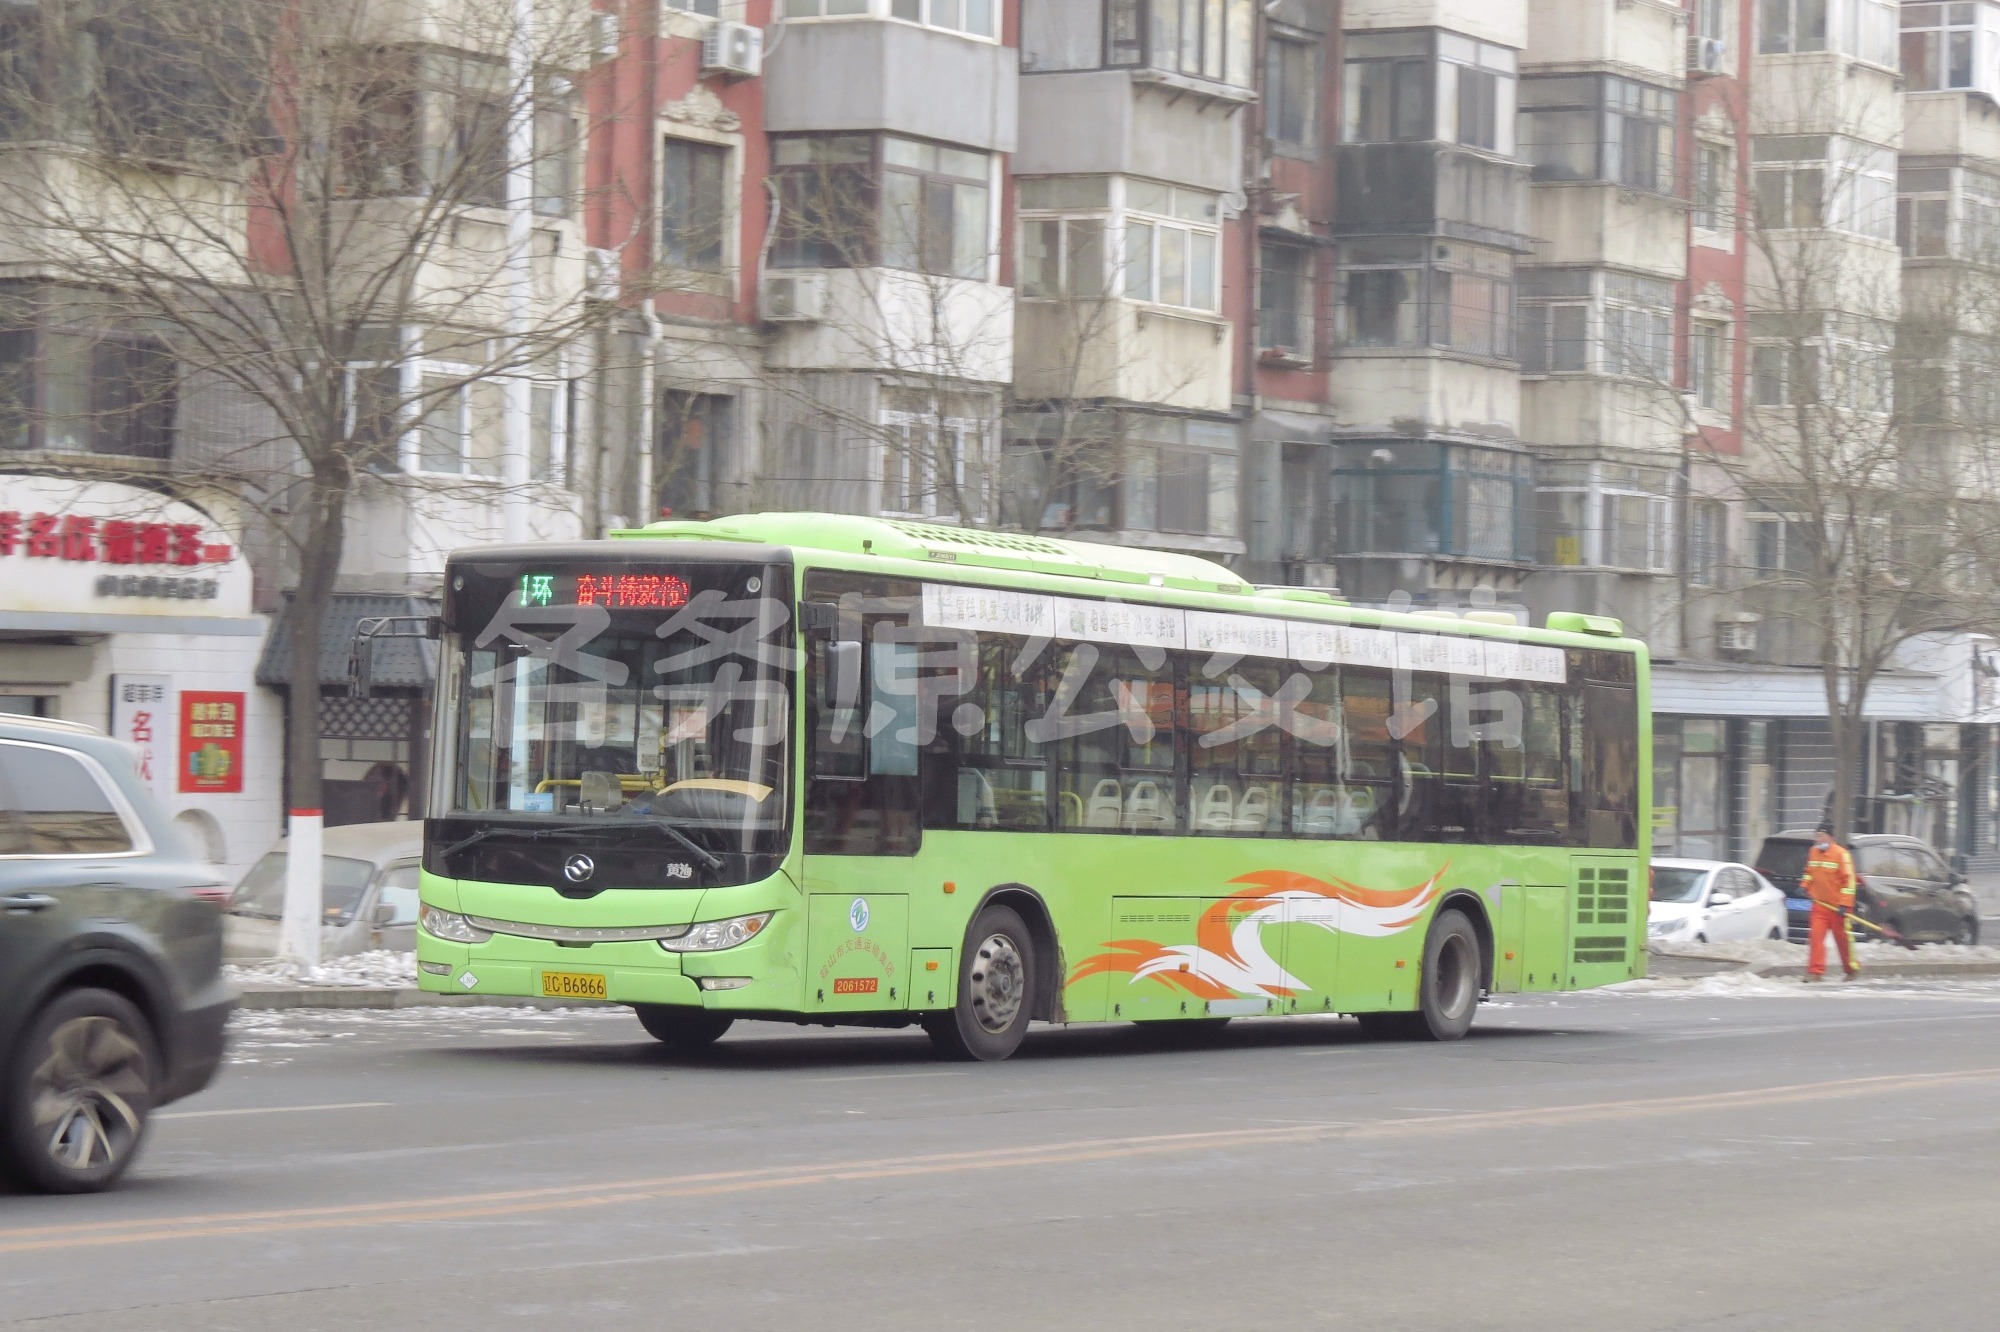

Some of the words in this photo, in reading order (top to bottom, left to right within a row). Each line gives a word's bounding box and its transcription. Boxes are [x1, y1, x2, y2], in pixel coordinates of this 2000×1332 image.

[819, 936, 895, 979] 鞍山市交通运输集团
[836, 980, 877, 992] 2061572
